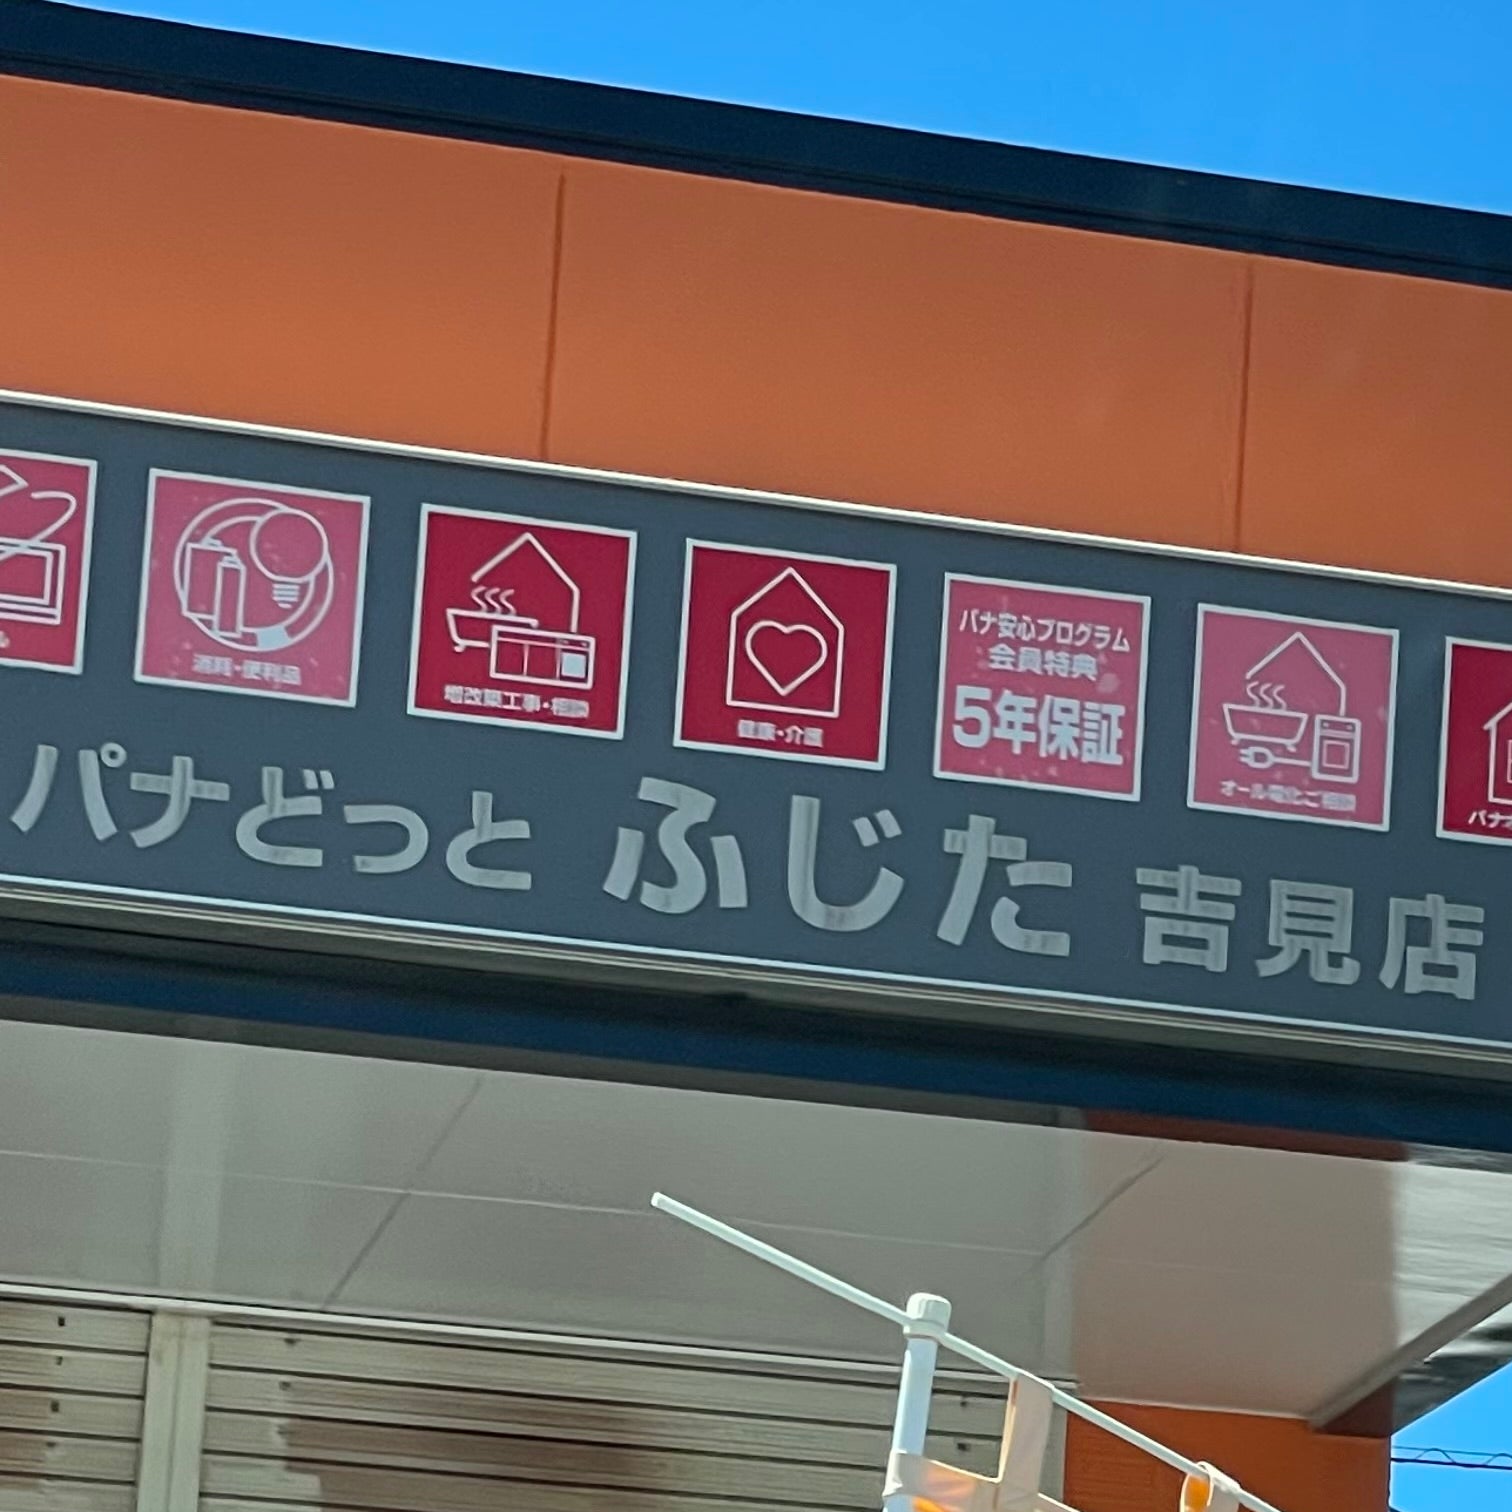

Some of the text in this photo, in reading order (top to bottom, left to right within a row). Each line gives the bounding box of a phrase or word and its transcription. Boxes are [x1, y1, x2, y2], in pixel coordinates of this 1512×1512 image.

[988, 643, 1098, 681] 会員特典
[953, 684, 1126, 765] 5年保証
[10, 743, 1486, 1001] パナどっと ふじた 吉見店
